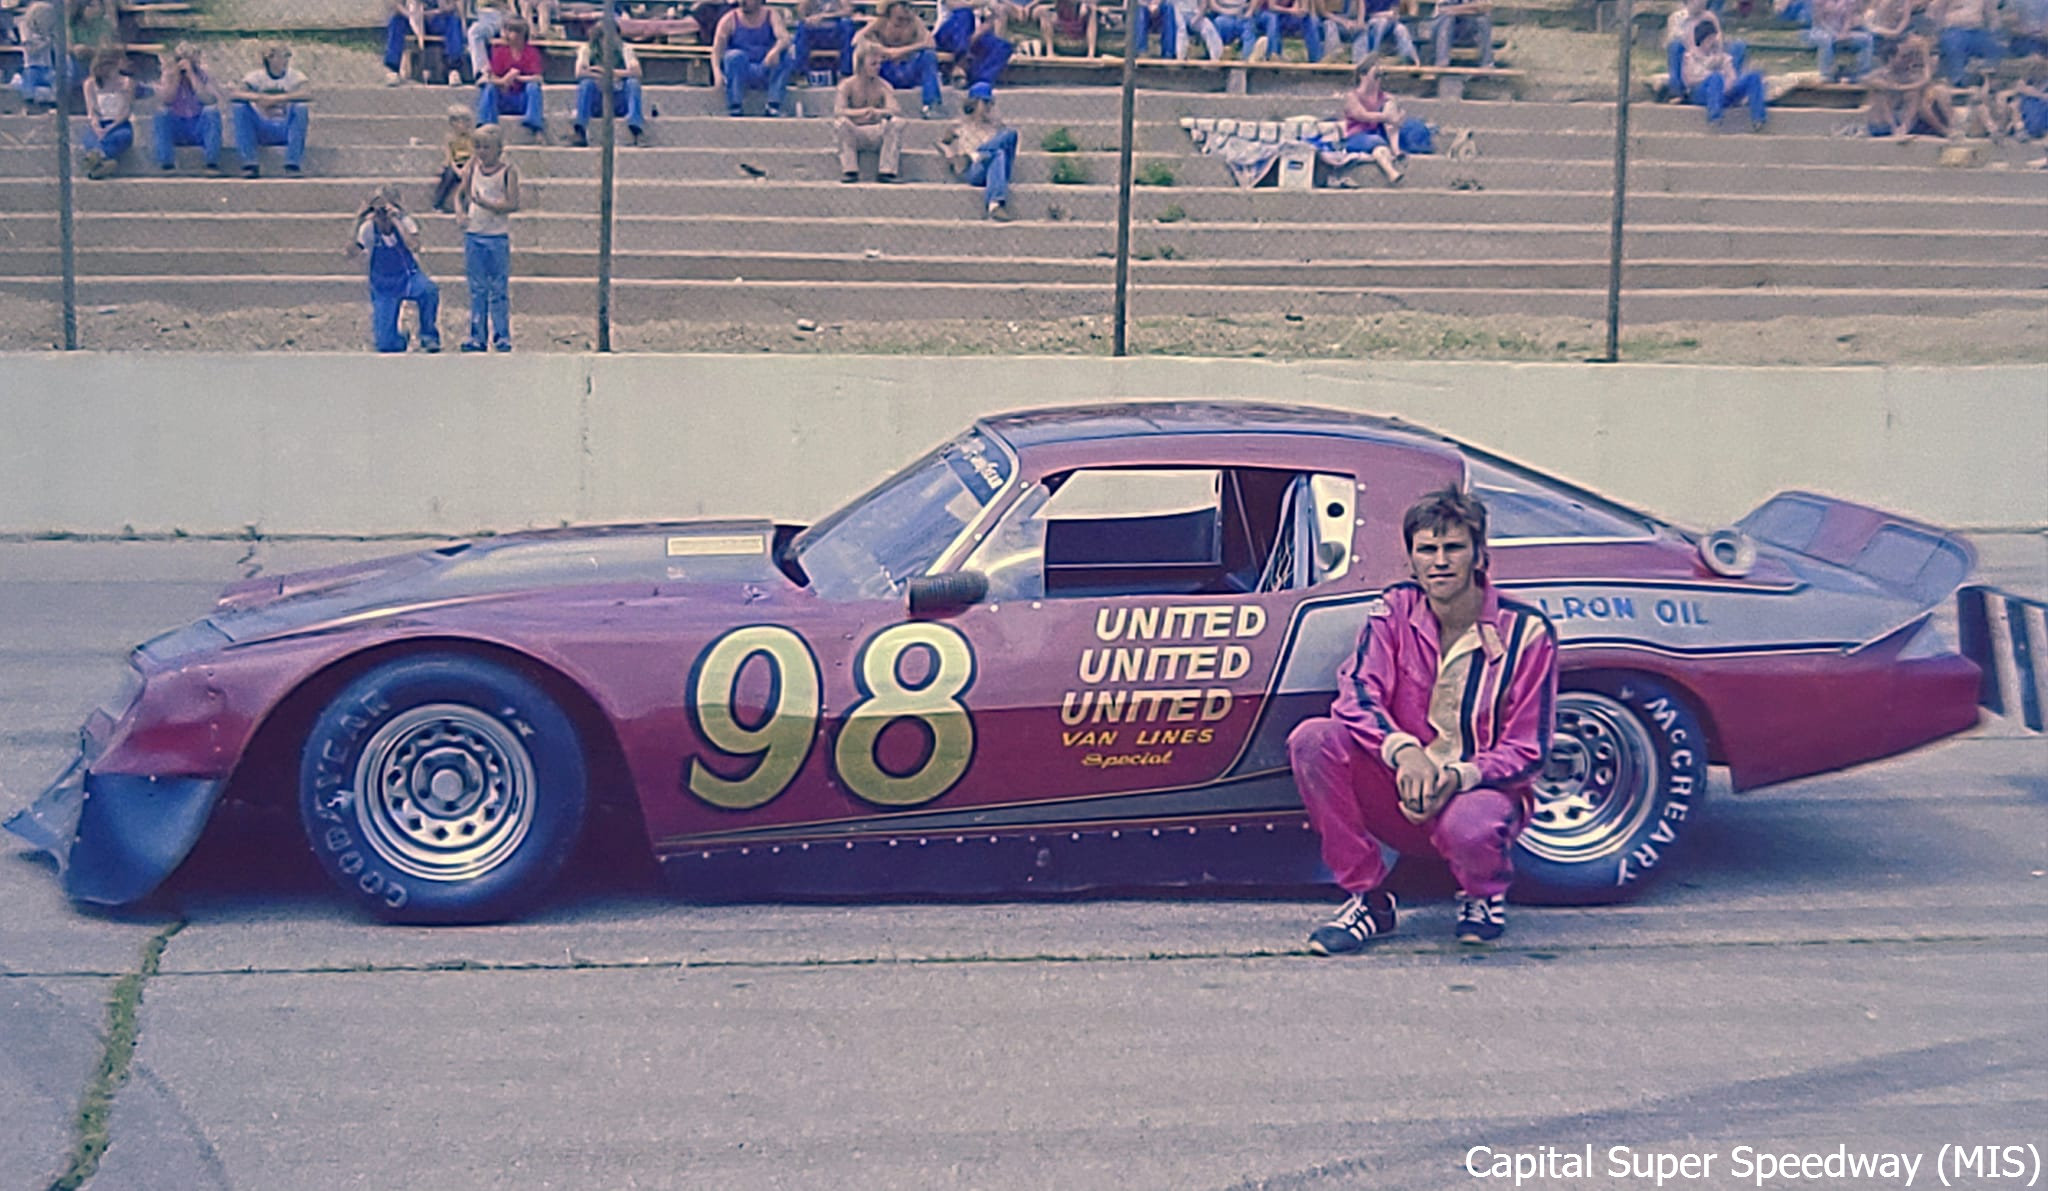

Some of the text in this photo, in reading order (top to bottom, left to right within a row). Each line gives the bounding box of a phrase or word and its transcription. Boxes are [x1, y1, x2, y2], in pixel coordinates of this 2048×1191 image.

[1096, 605, 1266, 641] UNITED
[1539, 597, 1710, 625] LRON OIL
[1079, 645, 1251, 684] UNITED
[686, 621, 977, 812] 98
[1061, 688, 1233, 725] UNITED
[1062, 728, 1215, 747] VAN LINES
[1081, 750, 1173, 769] Special
